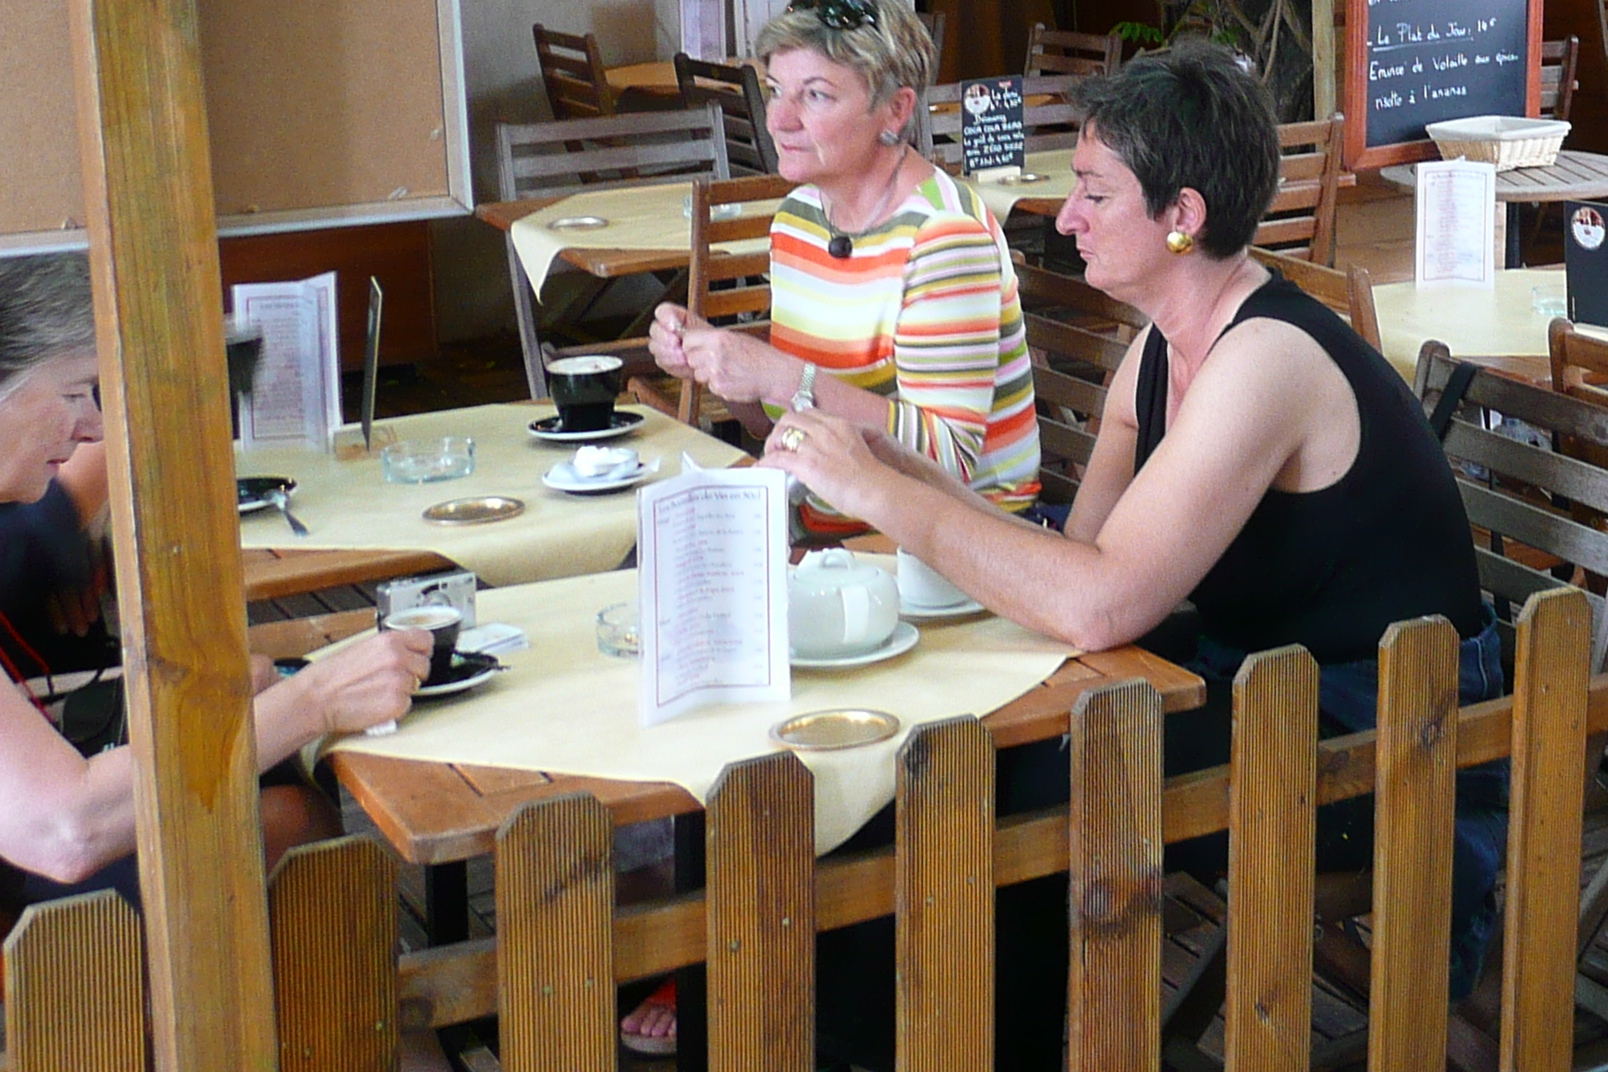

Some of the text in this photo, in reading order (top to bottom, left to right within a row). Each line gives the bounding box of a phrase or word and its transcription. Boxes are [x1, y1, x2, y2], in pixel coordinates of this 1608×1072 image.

[1378, 25, 1389, 46] Le
[1397, 23, 1424, 43] Plat
[1429, 23, 1440, 39] du
[1413, 58, 1423, 72] de
